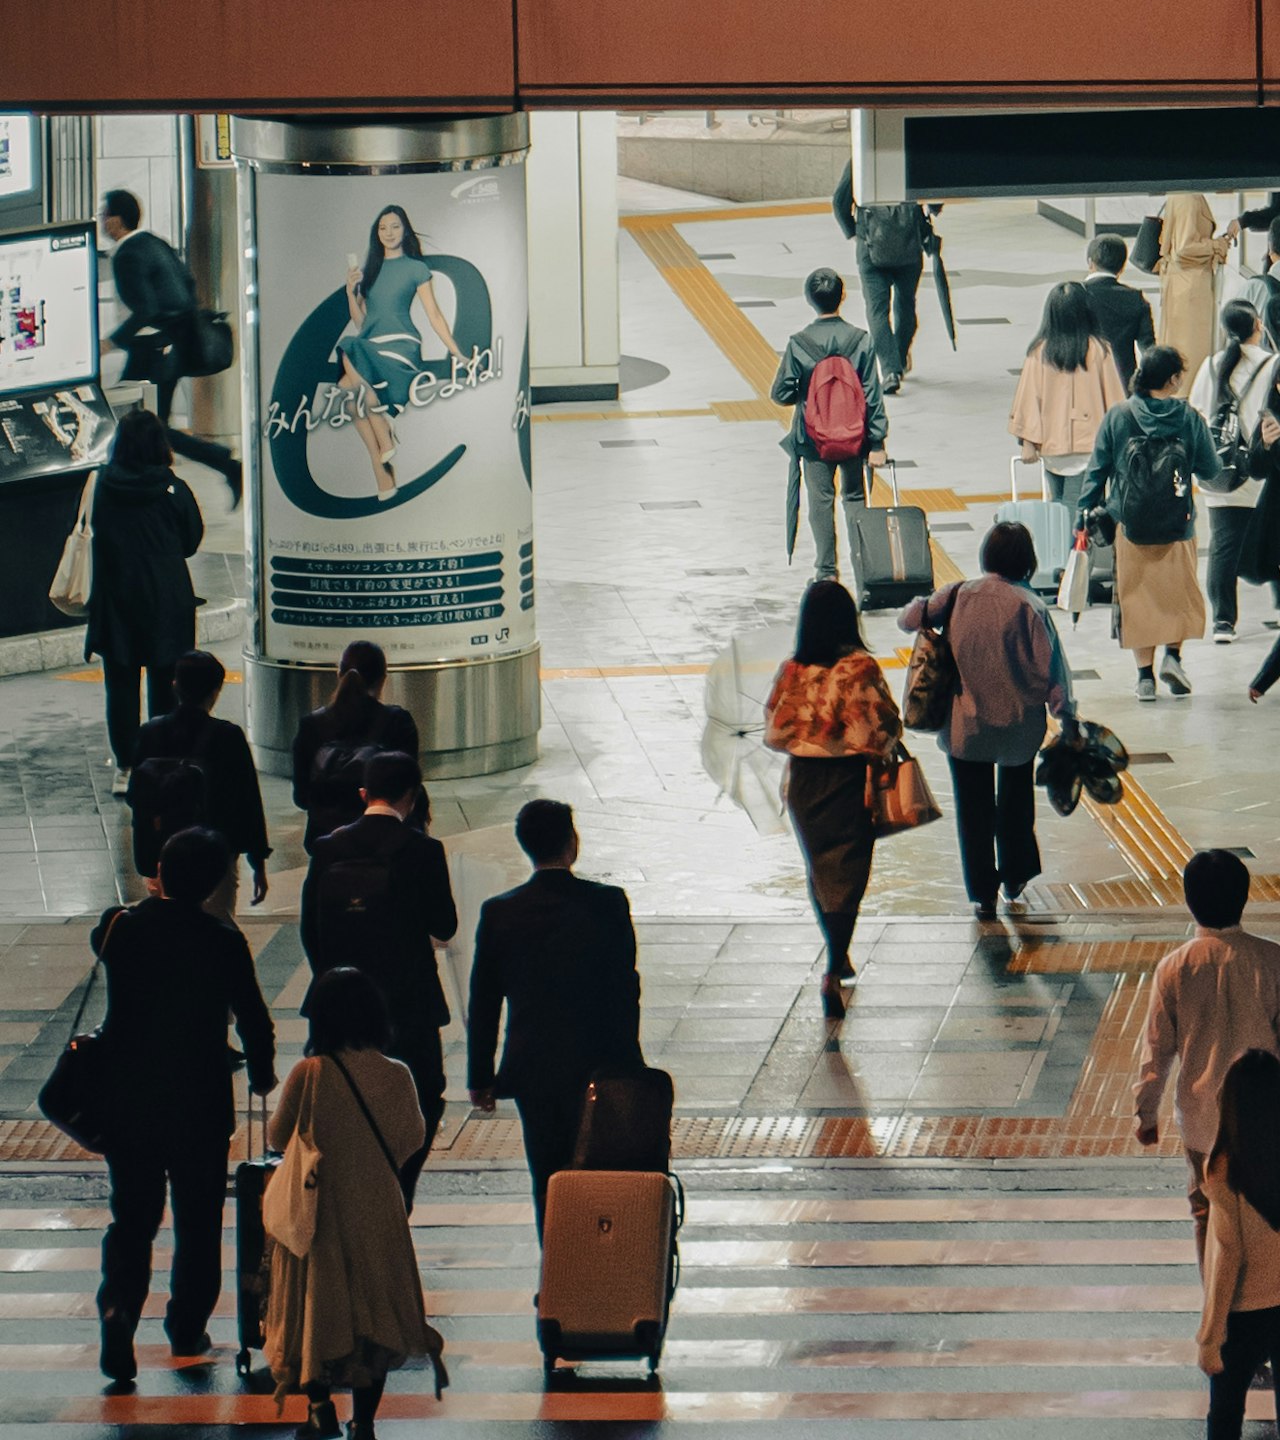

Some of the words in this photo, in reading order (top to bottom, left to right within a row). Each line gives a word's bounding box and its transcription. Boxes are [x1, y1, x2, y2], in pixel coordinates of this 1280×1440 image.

[263, 337, 504, 441] みんなに、eよね!
